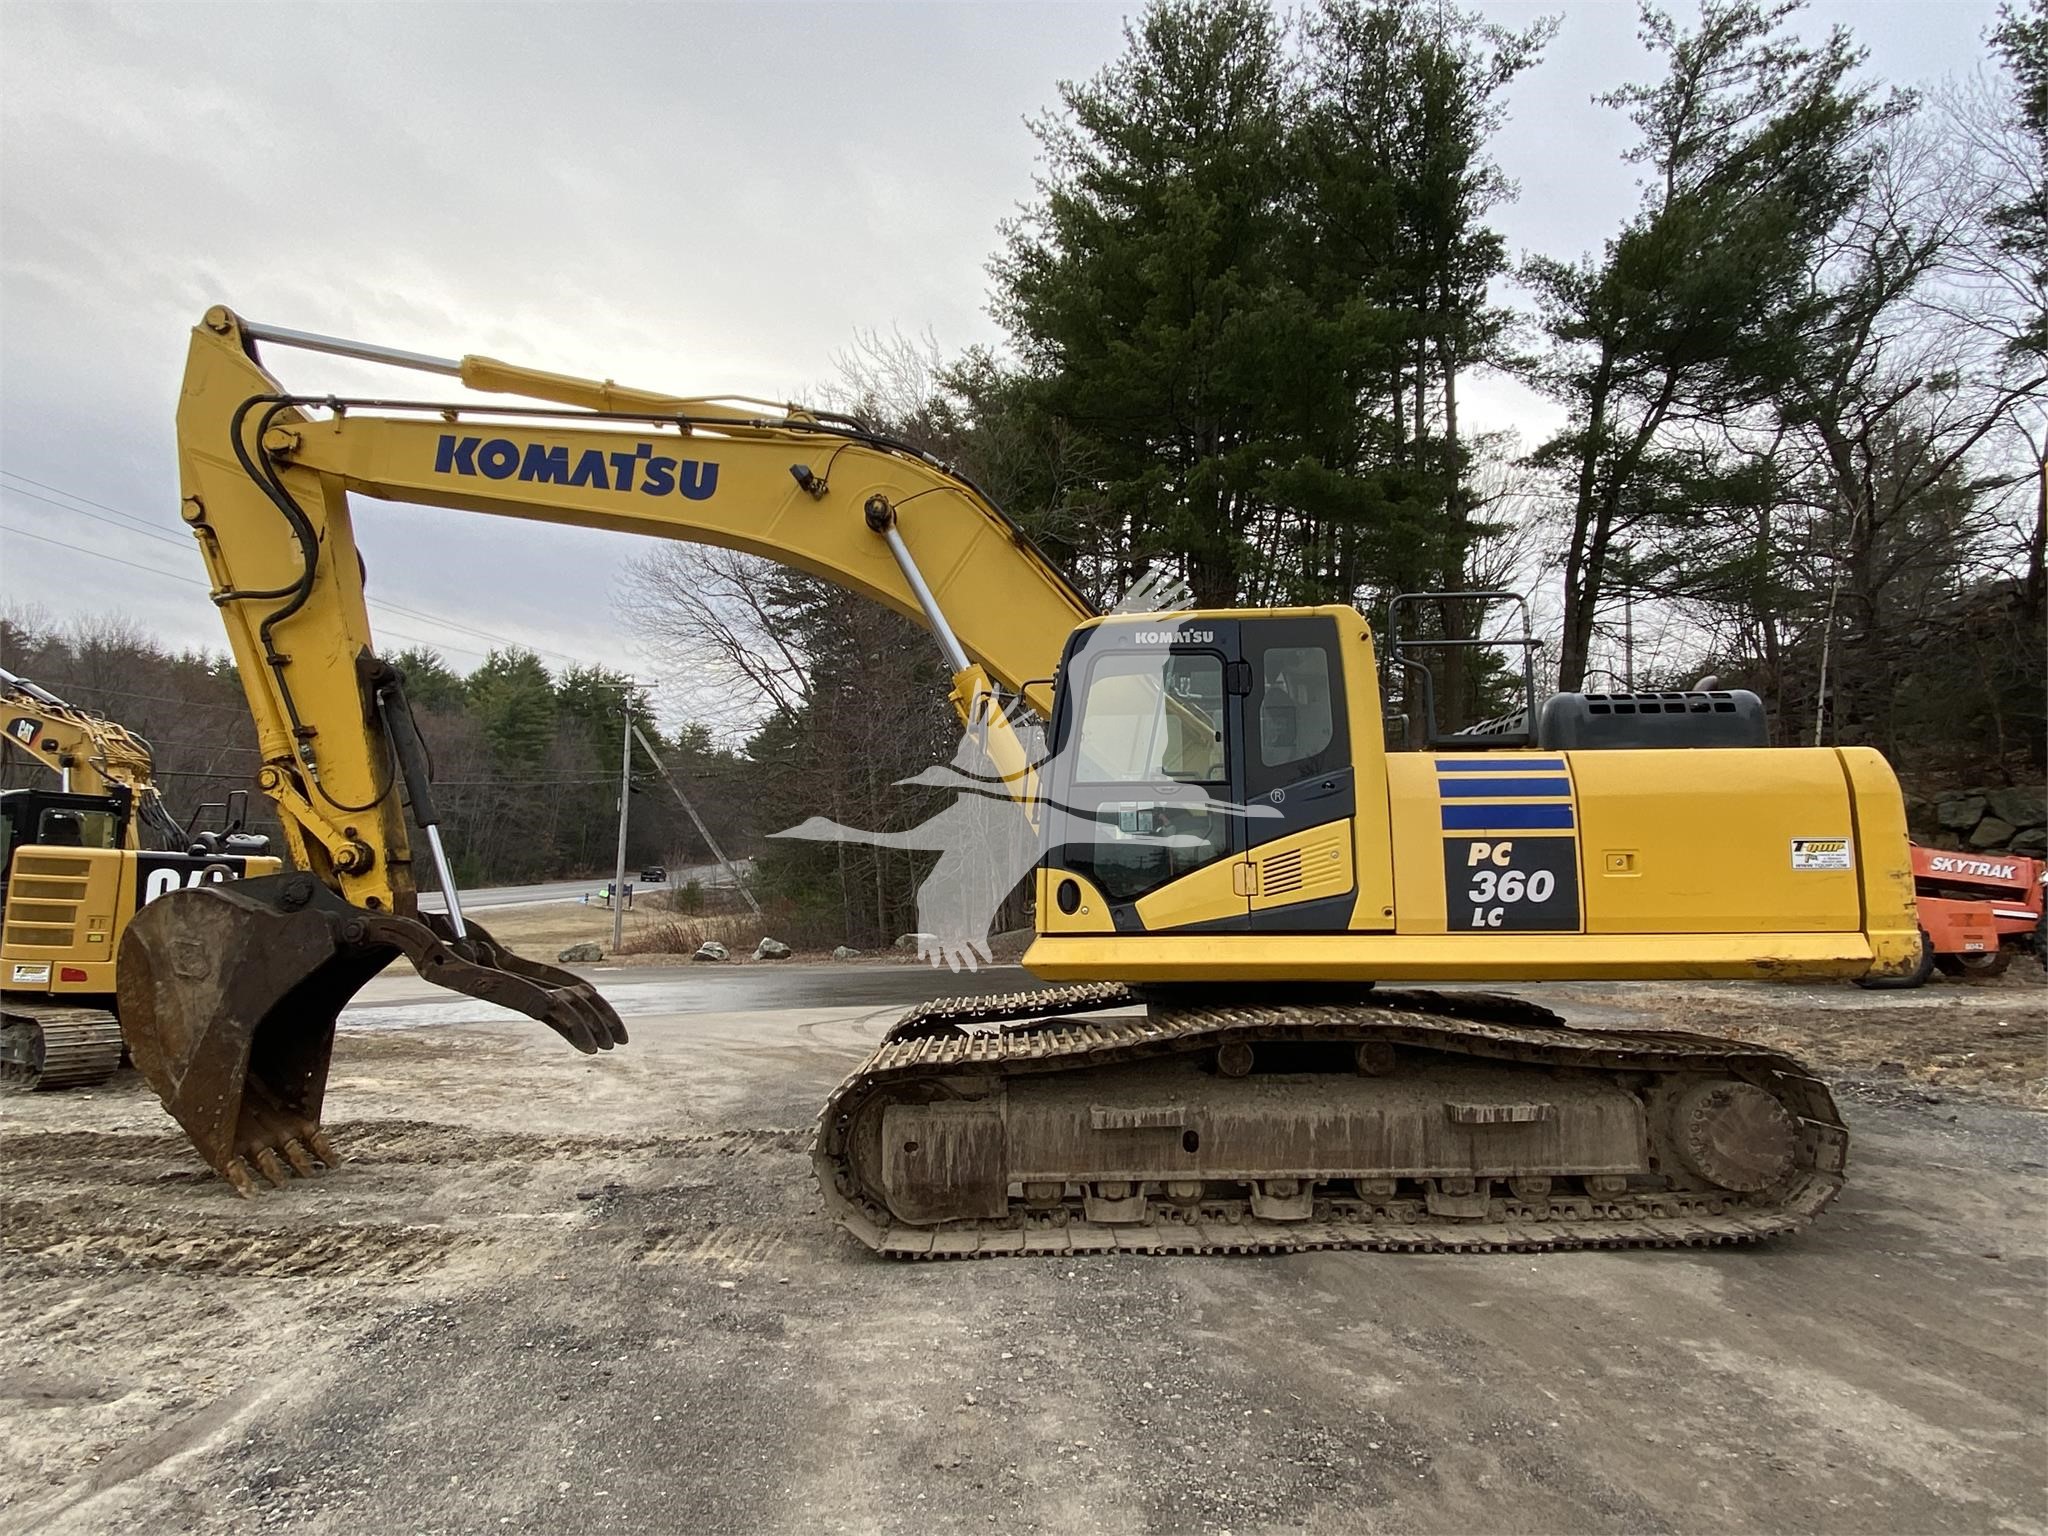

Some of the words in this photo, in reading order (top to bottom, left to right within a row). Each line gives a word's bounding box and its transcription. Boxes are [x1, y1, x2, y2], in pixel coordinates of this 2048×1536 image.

[434, 434, 720, 501] KOMATSU
[1135, 628, 1214, 644] KOMATSU
[17, 719, 35, 744] CAT
[1467, 842, 1513, 867] PC
[1930, 856, 2017, 880] SKYTRAK
[1468, 870, 1556, 903] 360
[1471, 907, 1505, 928] LC
